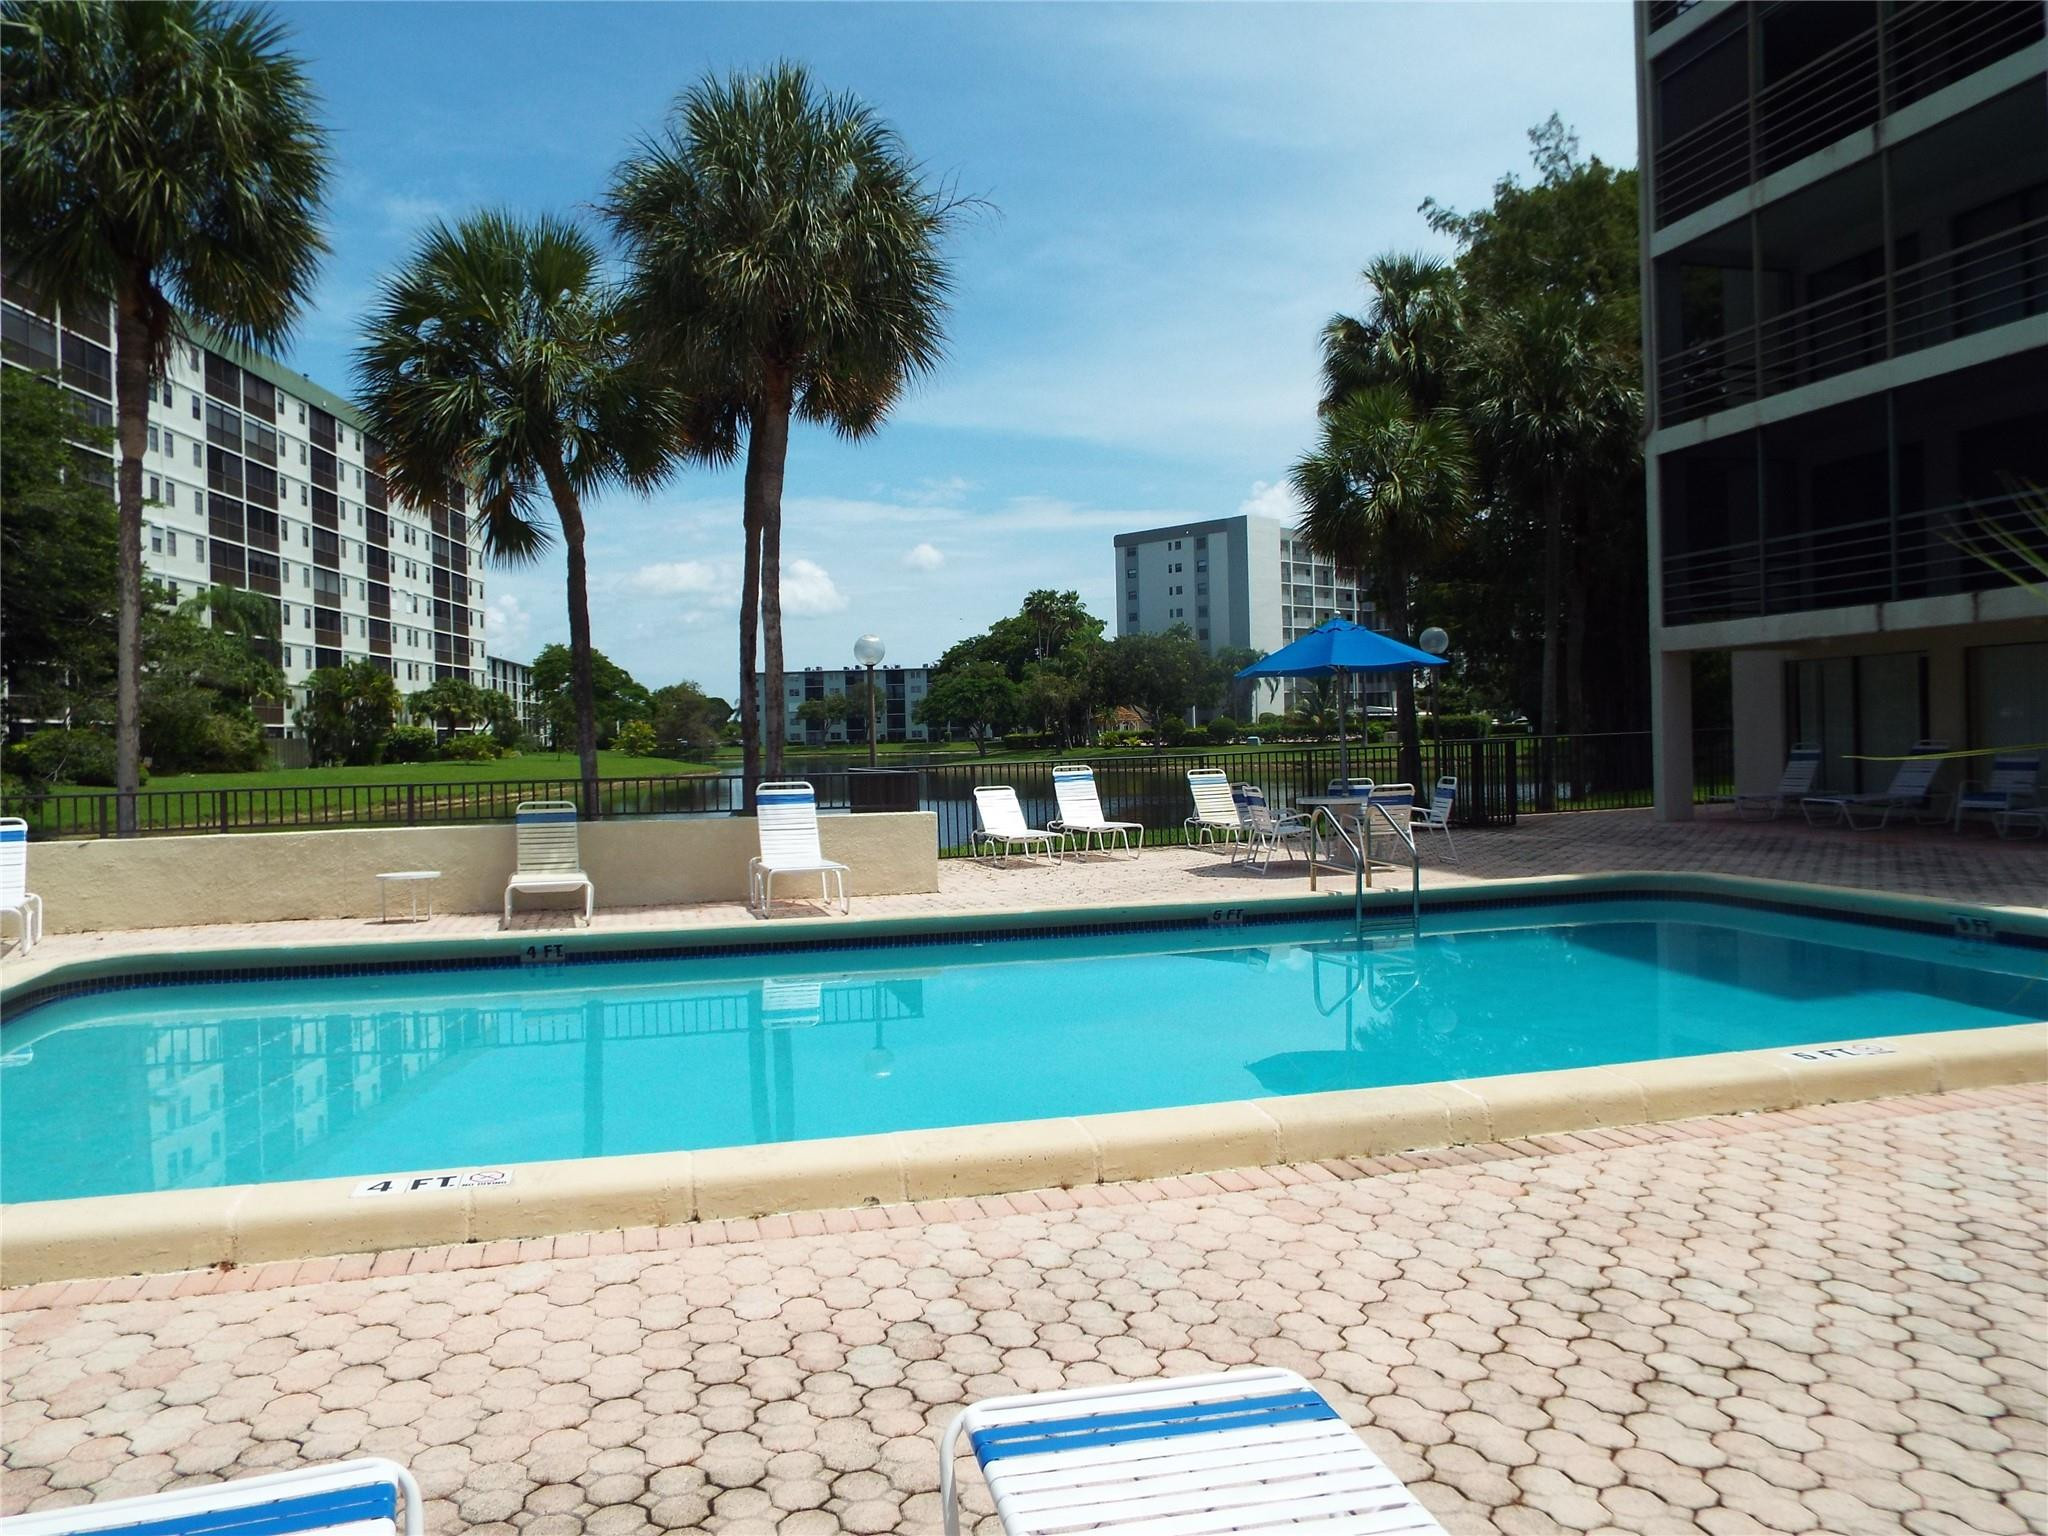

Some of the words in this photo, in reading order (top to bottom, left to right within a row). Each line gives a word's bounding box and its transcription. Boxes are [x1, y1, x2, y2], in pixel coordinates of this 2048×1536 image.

[526, 945, 537, 959] 4
[367, 1181, 393, 1192] 4
[410, 1175, 458, 1190] FT.
